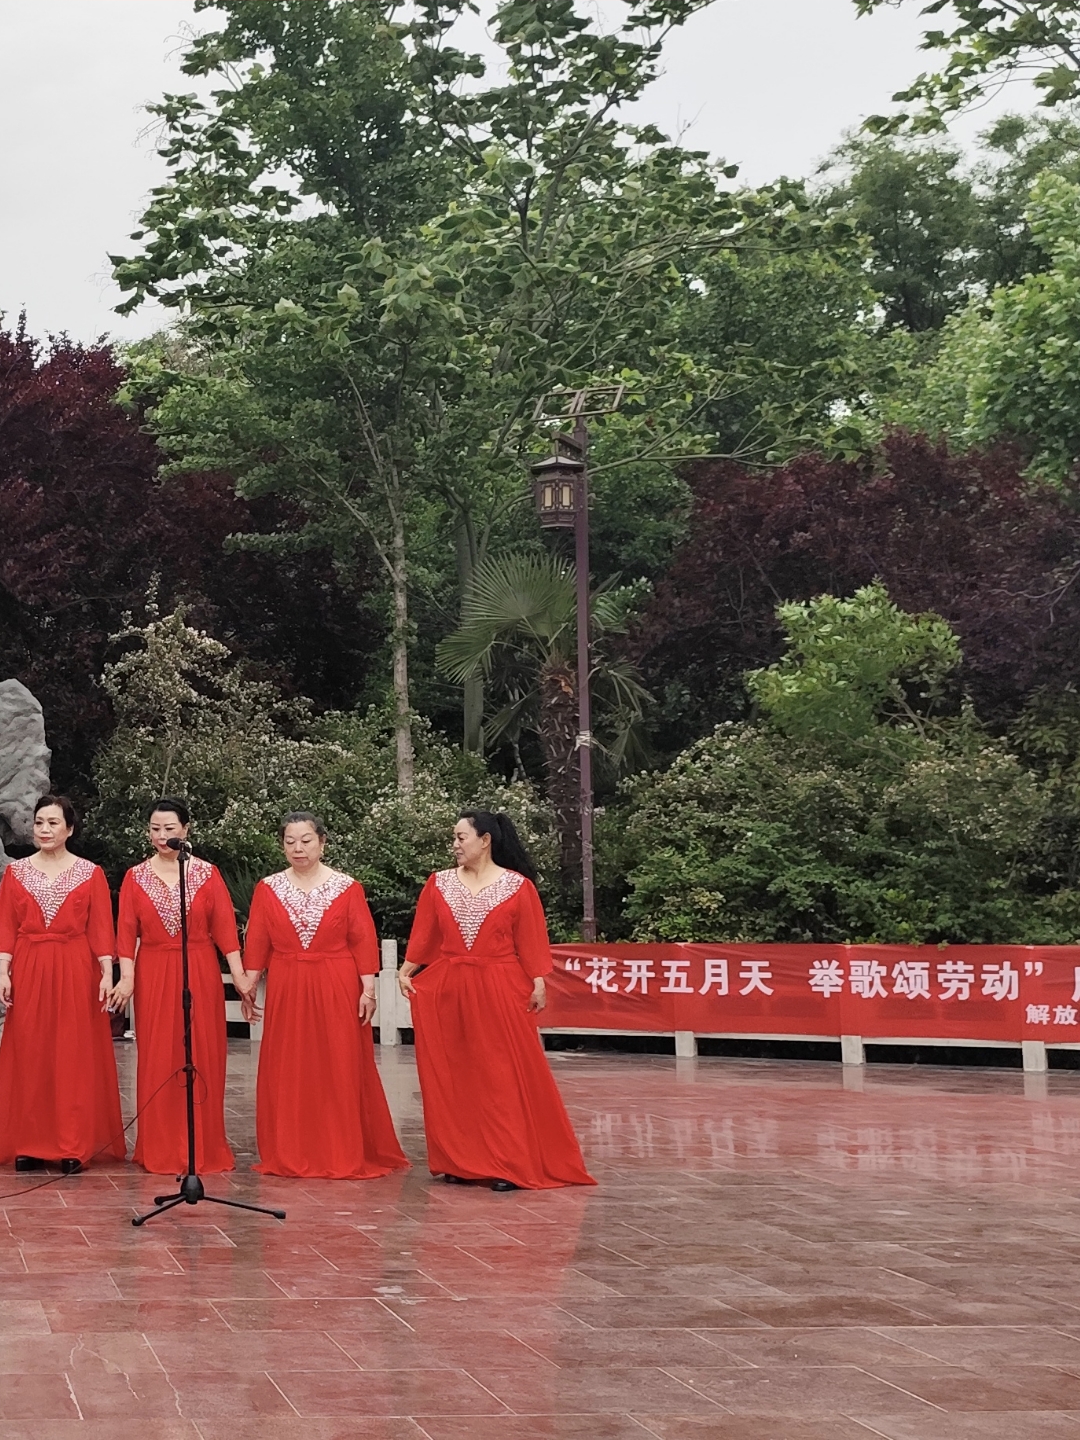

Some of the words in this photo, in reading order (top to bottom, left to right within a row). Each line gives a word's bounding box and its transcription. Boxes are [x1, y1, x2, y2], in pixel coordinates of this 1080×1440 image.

[564, 956, 774, 996] “花开五月天
[808, 959, 1044, 1001] 举歌颂劳动”
[1025, 1003, 1078, 1025] 解放
